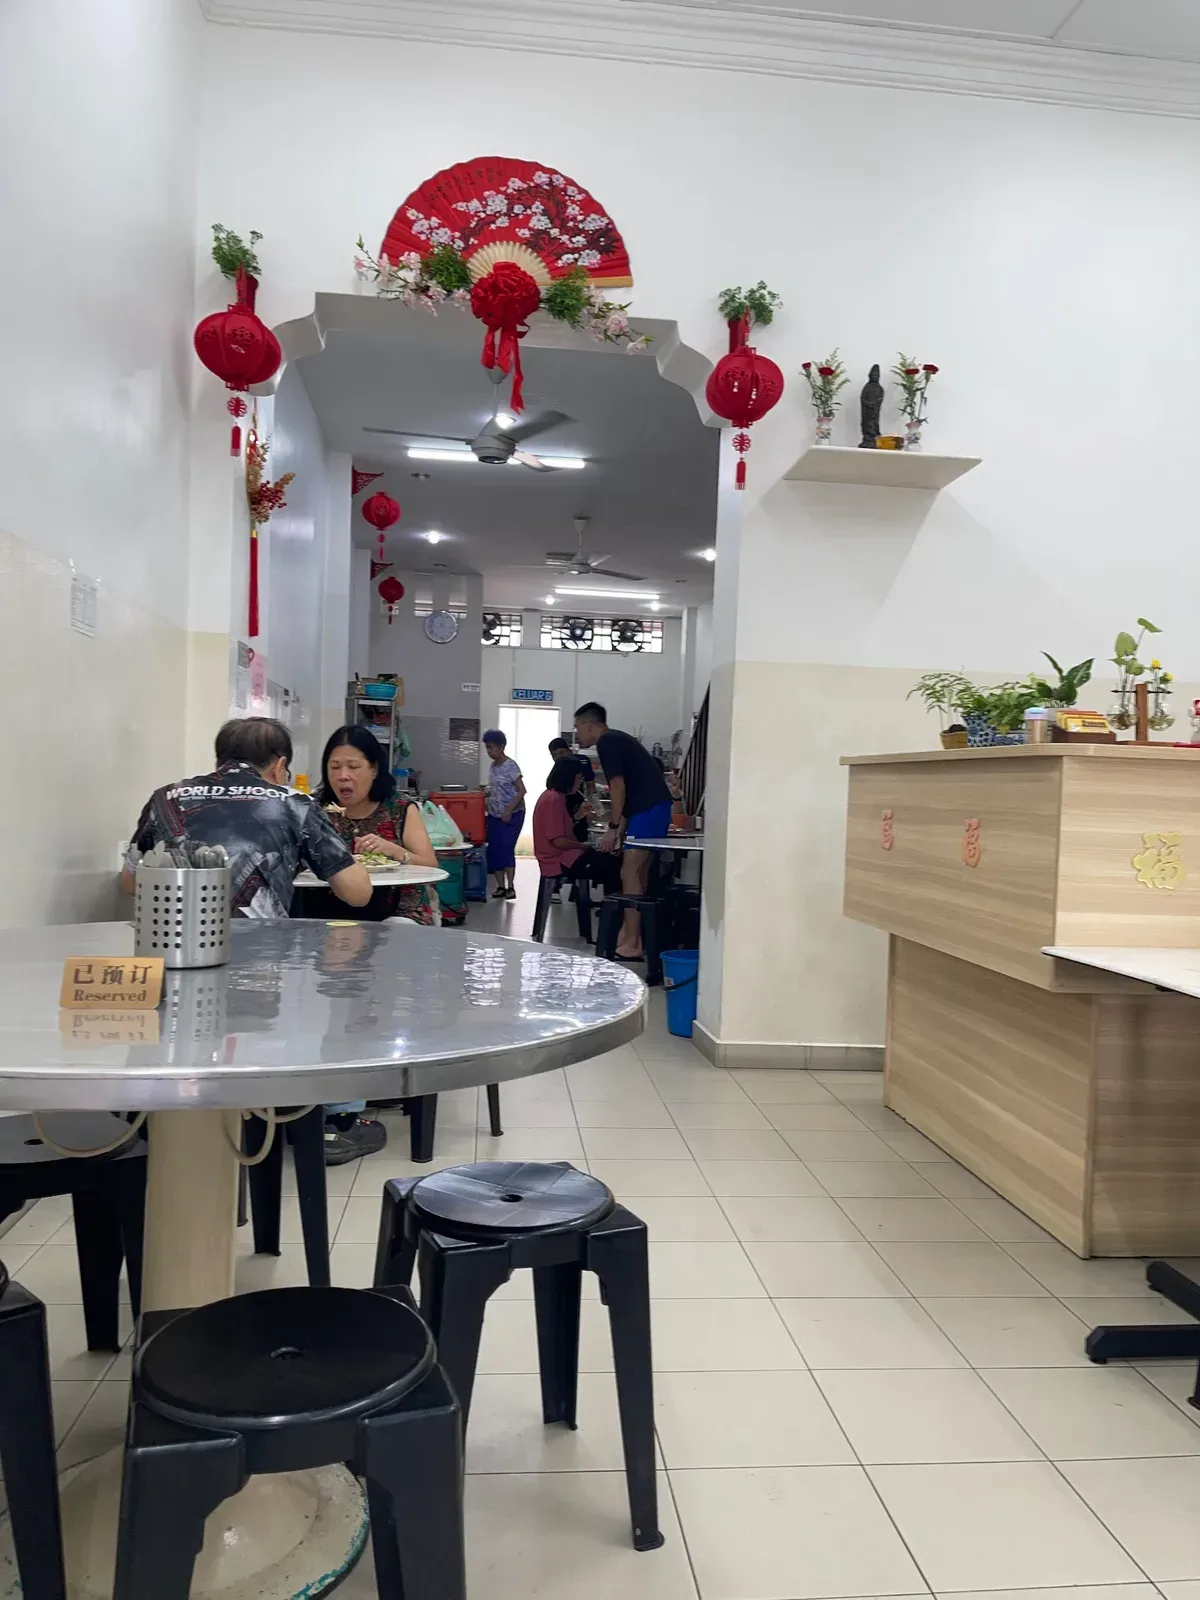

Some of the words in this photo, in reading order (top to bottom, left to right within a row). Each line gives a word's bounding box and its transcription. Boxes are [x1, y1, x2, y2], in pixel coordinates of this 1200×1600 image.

[167, 786, 225, 800] WORLD
[227, 786, 289, 801] SHOOT
[73, 964, 153, 985] 已预订
[73, 989, 147, 1002] Reserved
